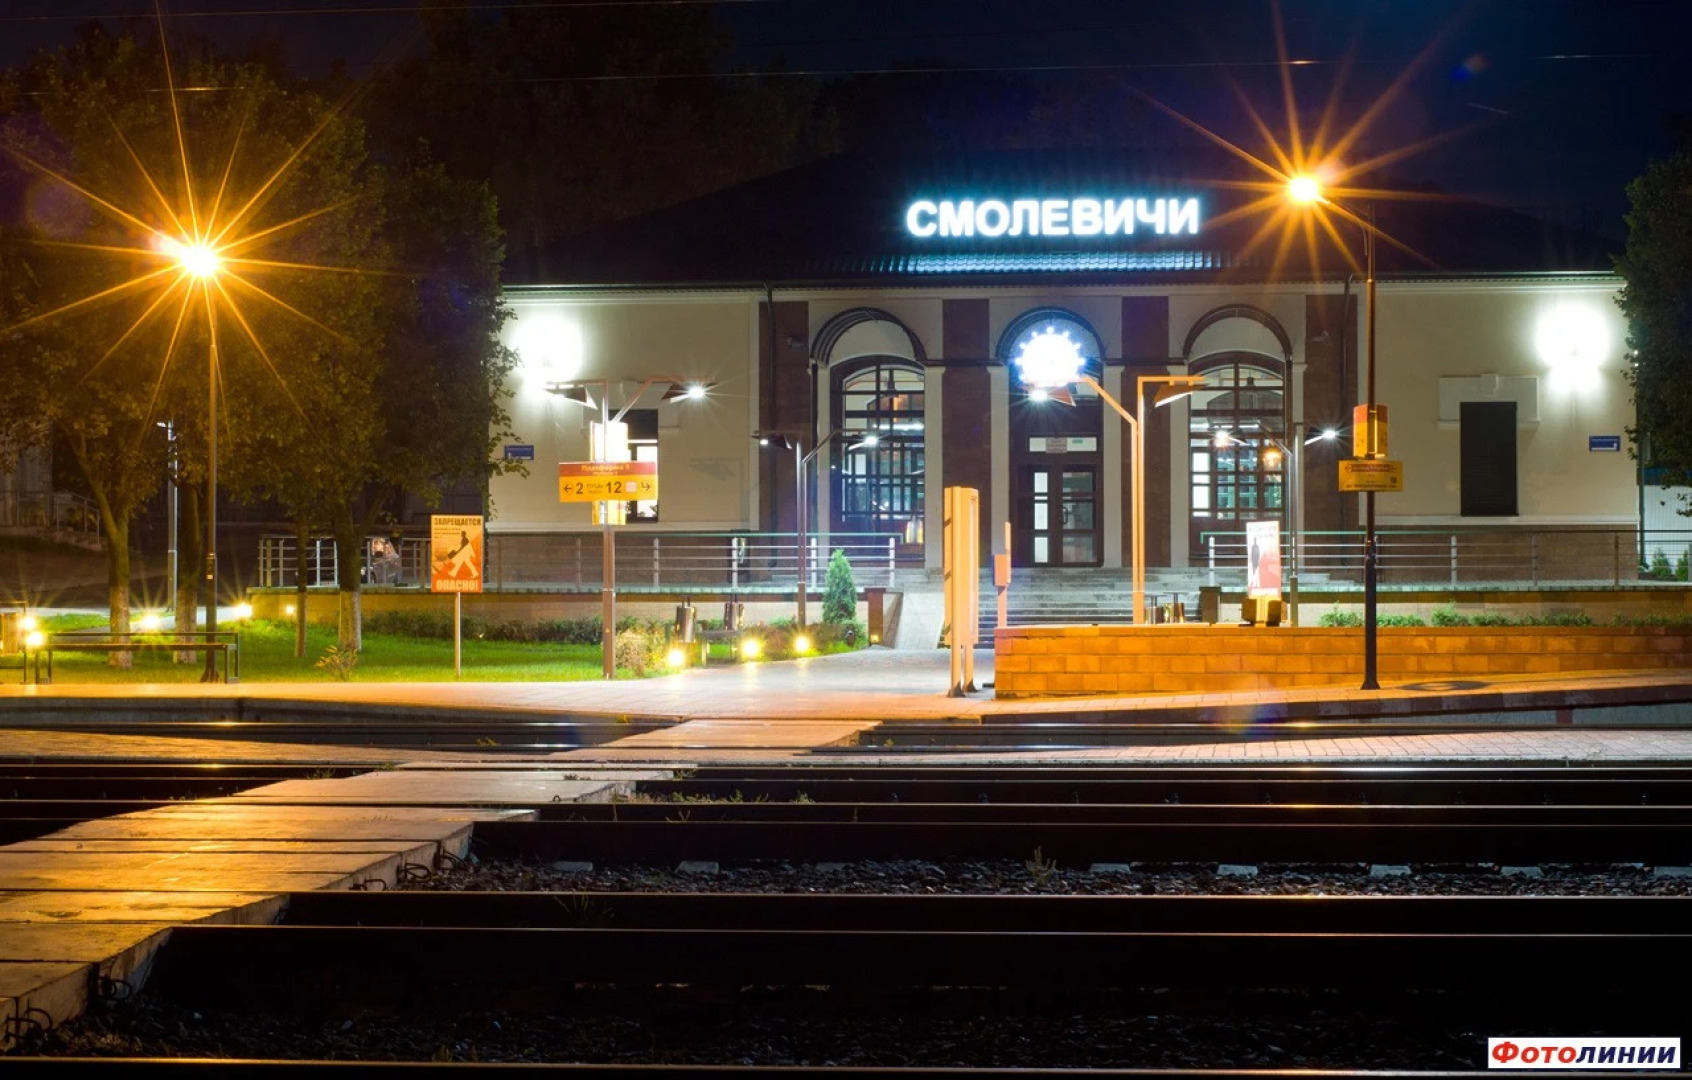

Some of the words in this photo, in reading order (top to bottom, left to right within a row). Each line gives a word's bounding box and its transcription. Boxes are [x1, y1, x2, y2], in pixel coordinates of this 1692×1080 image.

[906, 198, 1199, 237] СМОЛЕВИЧИ
[576, 482, 584, 494] 2
[606, 481, 622, 493] 12
[434, 518, 481, 526] ЗАПРЕЩАЕТСЯ
[436, 579, 478, 591] ОПАСНО!
